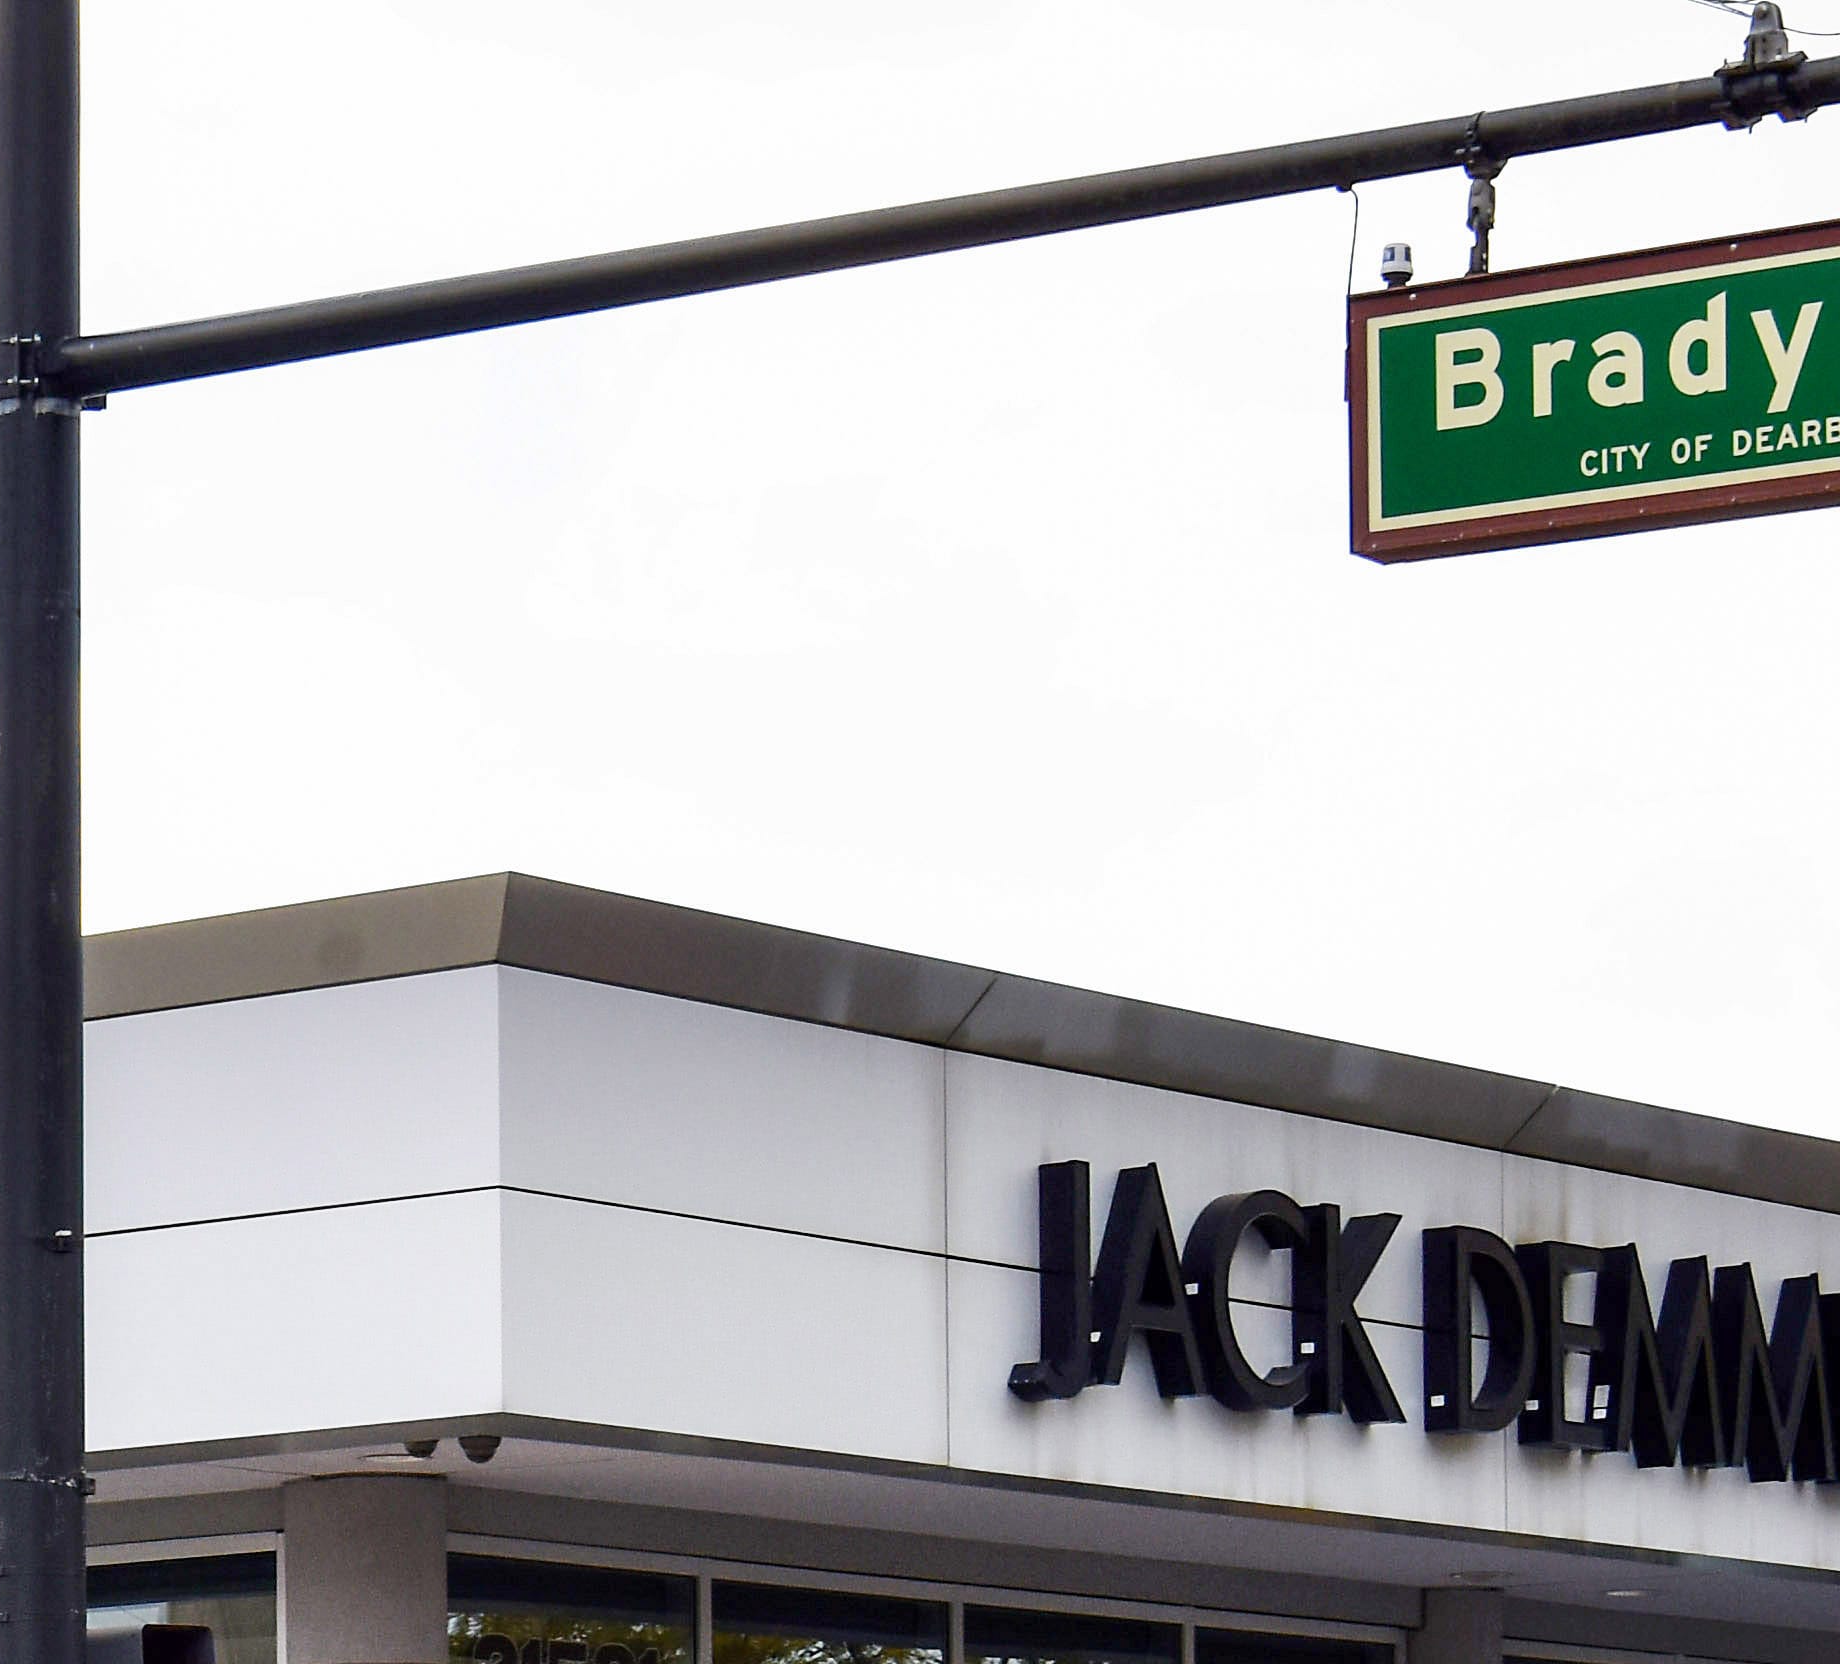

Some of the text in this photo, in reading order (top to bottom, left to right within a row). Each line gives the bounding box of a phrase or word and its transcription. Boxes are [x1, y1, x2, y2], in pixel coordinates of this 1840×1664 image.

[1435, 291, 1823, 431] Brady
[1580, 441, 1650, 478] CITY
[1671, 433, 1714, 465] OF
[1007, 1159, 1407, 1425] JACK
